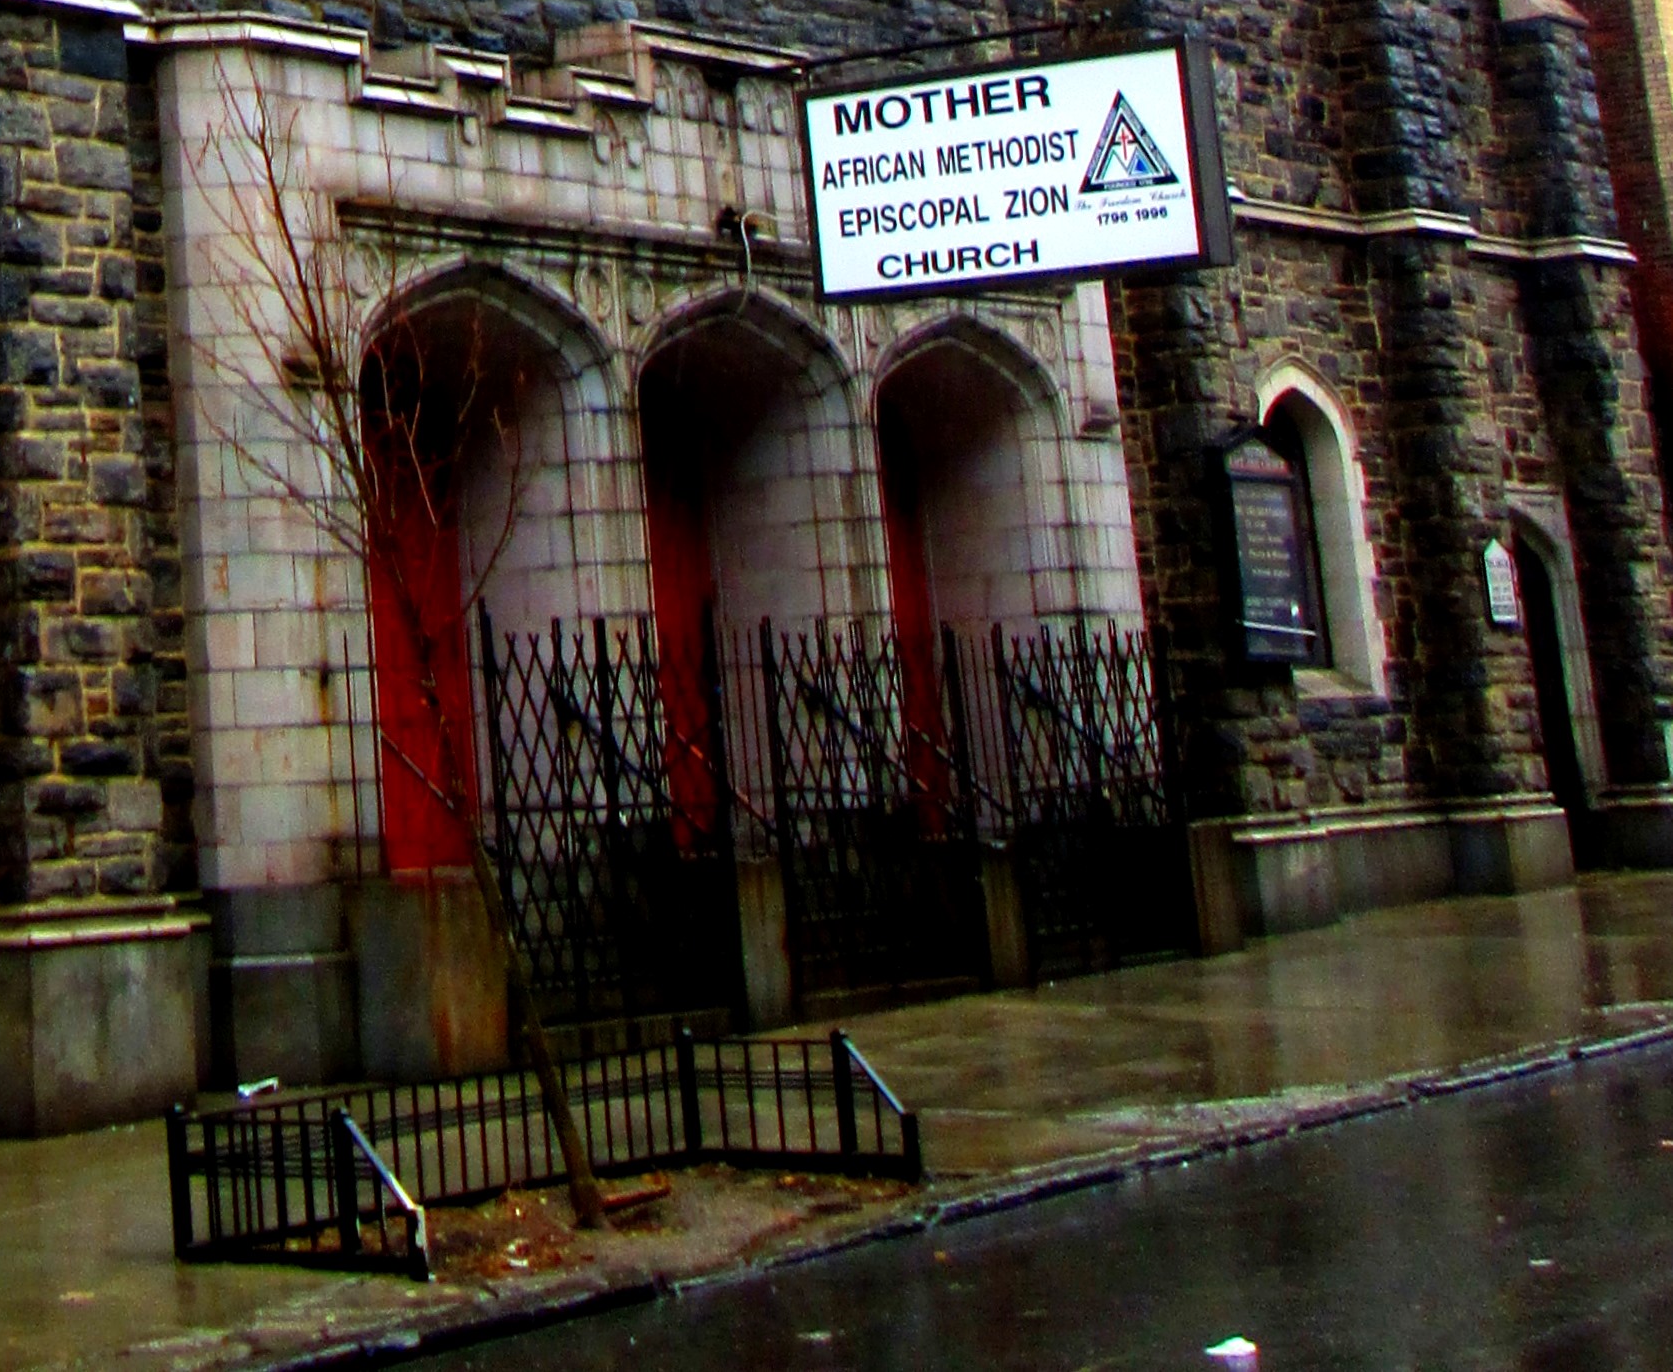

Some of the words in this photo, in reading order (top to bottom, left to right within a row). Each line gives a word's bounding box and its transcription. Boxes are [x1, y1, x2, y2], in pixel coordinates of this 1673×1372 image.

[833, 74, 1051, 137] MOTHER
[822, 148, 926, 191] AFRICAN
[937, 129, 1079, 177] METHODIST
[839, 193, 990, 238] EPISCOPAL
[1004, 184, 1069, 219] ZION
[1096, 210, 1129, 227] 1796
[1135, 206, 1169, 223] 1996
[1149, 188, 1187, 202] Church
[876, 239, 1040, 280] CHURCH
